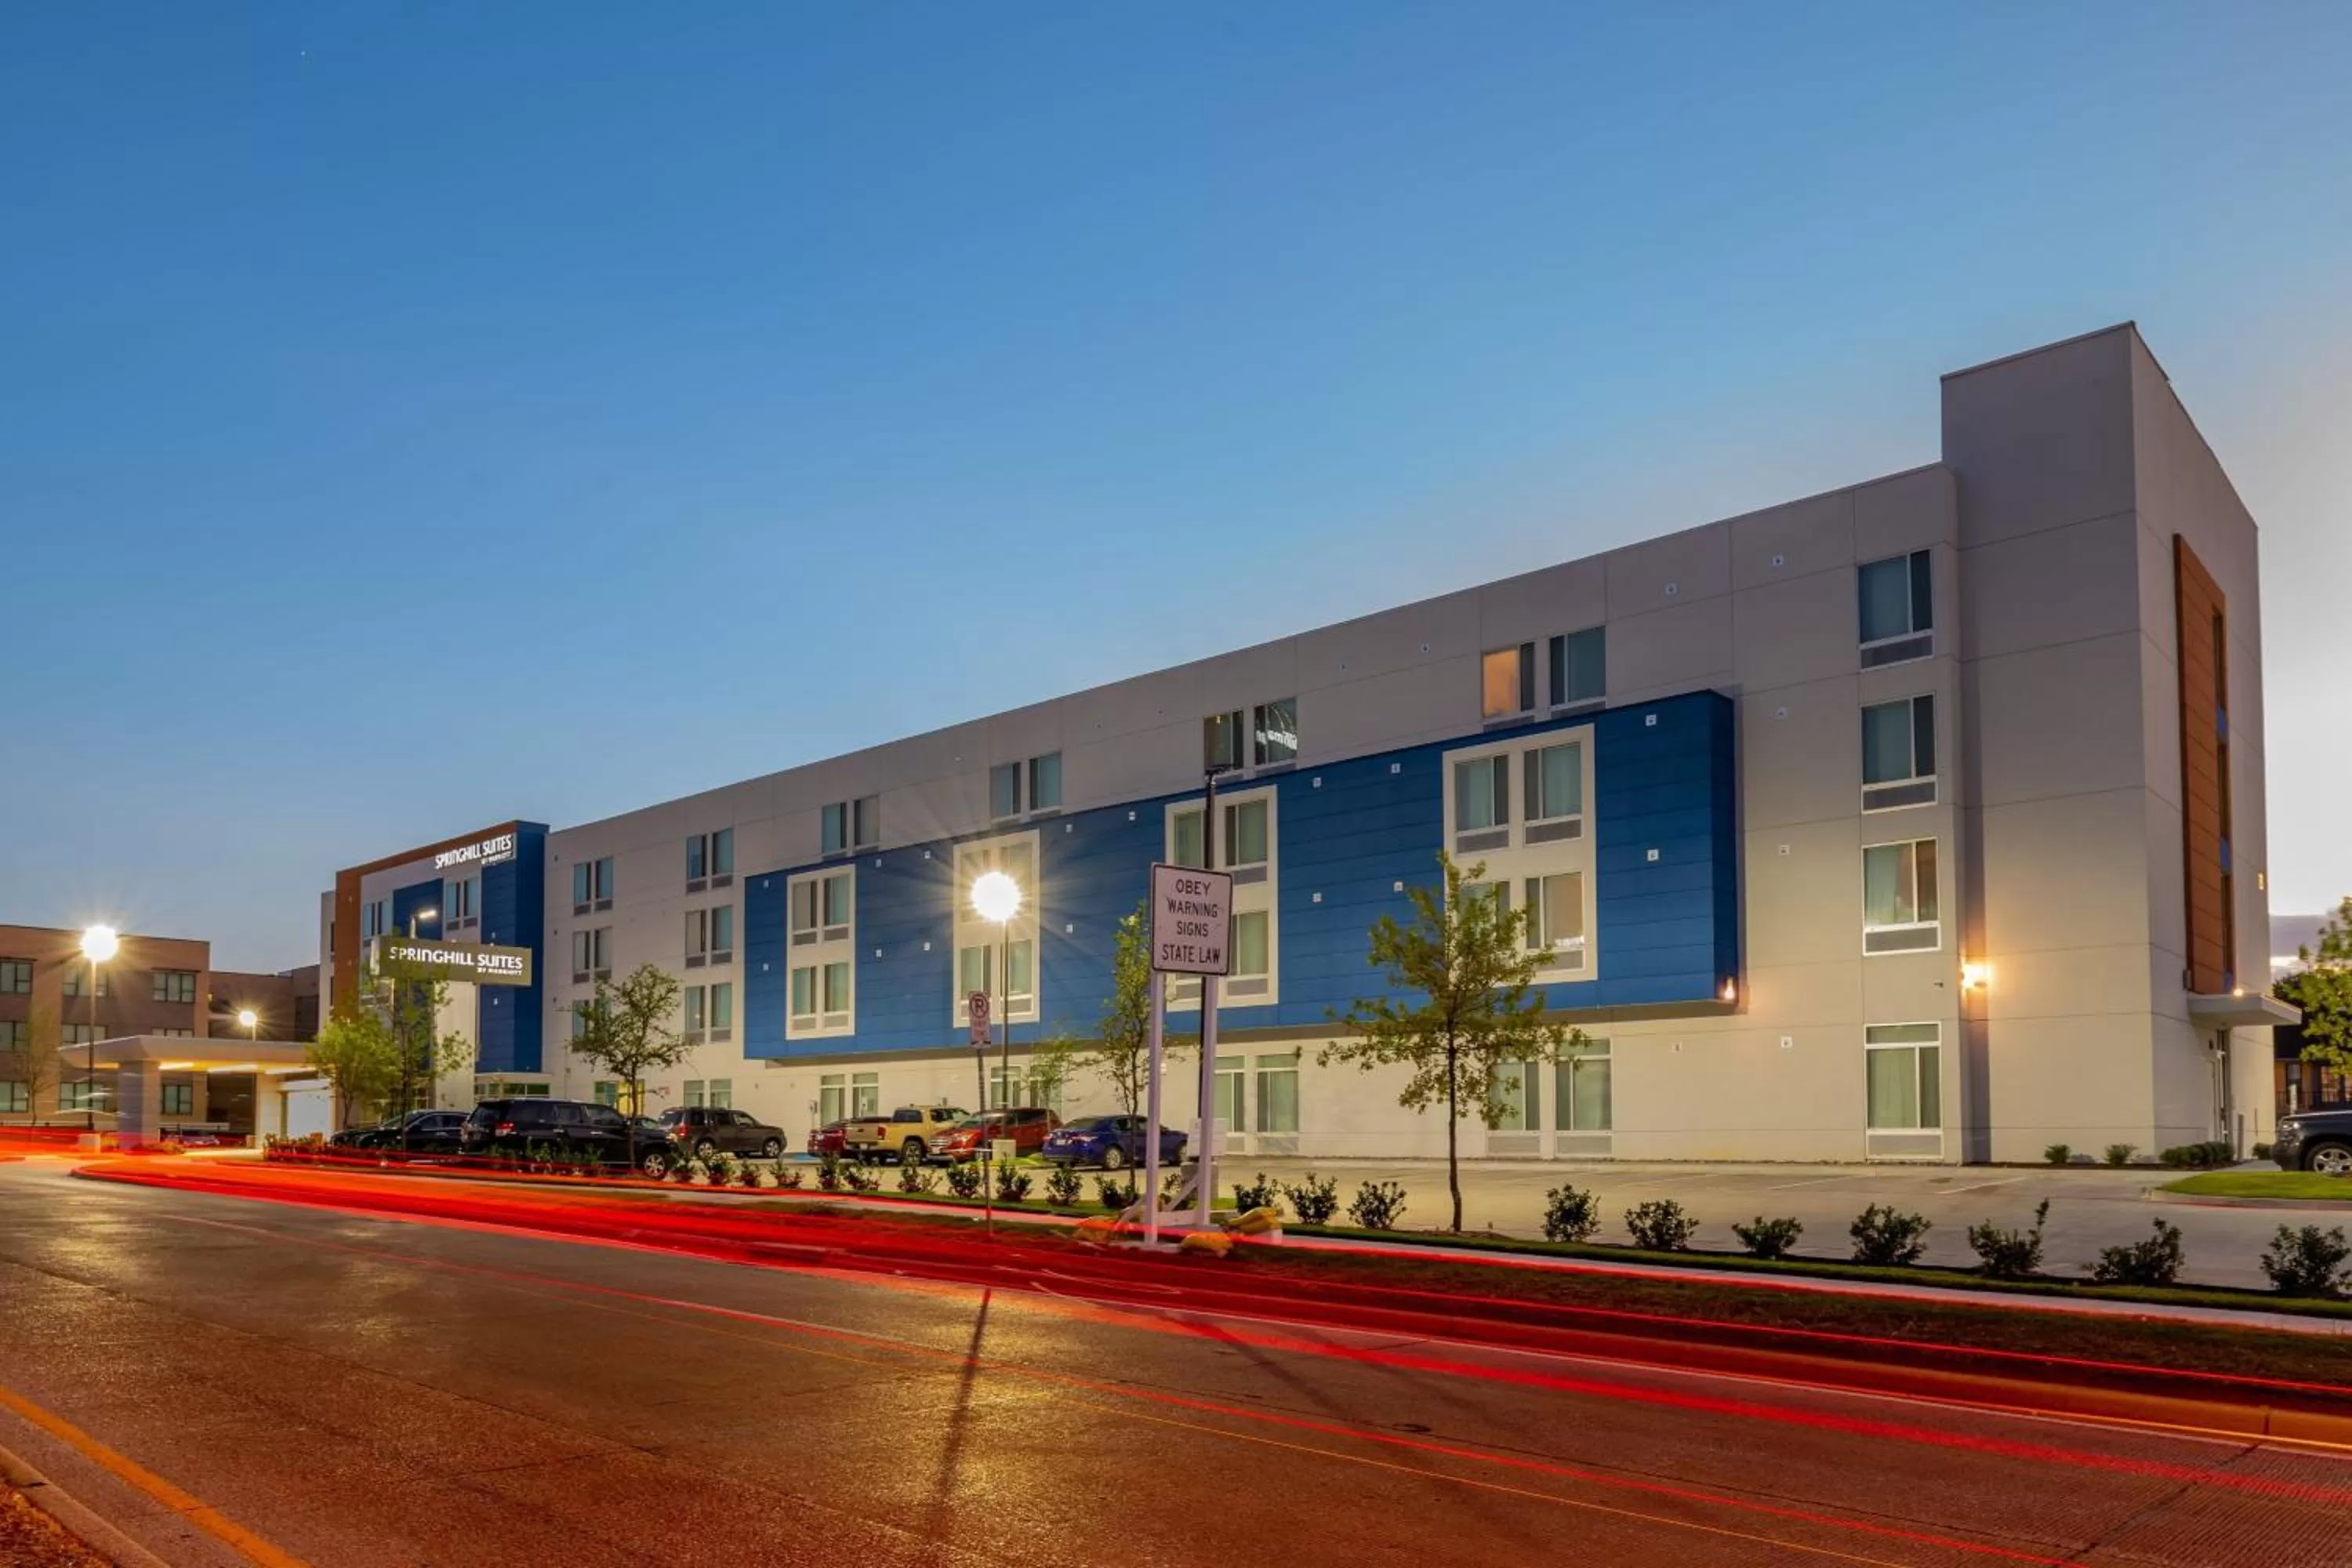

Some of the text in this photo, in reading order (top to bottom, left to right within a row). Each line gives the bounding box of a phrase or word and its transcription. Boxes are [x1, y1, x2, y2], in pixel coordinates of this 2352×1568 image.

[482, 834, 512, 856] SUITES
[1176, 879, 1211, 896] OBEY
[1167, 897, 1218, 918] WARNING
[1177, 921, 1209, 937] SIGNS
[389, 946, 523, 969] SPRINGHILL SUITES
[1162, 944, 1221, 964] STATE LAW
